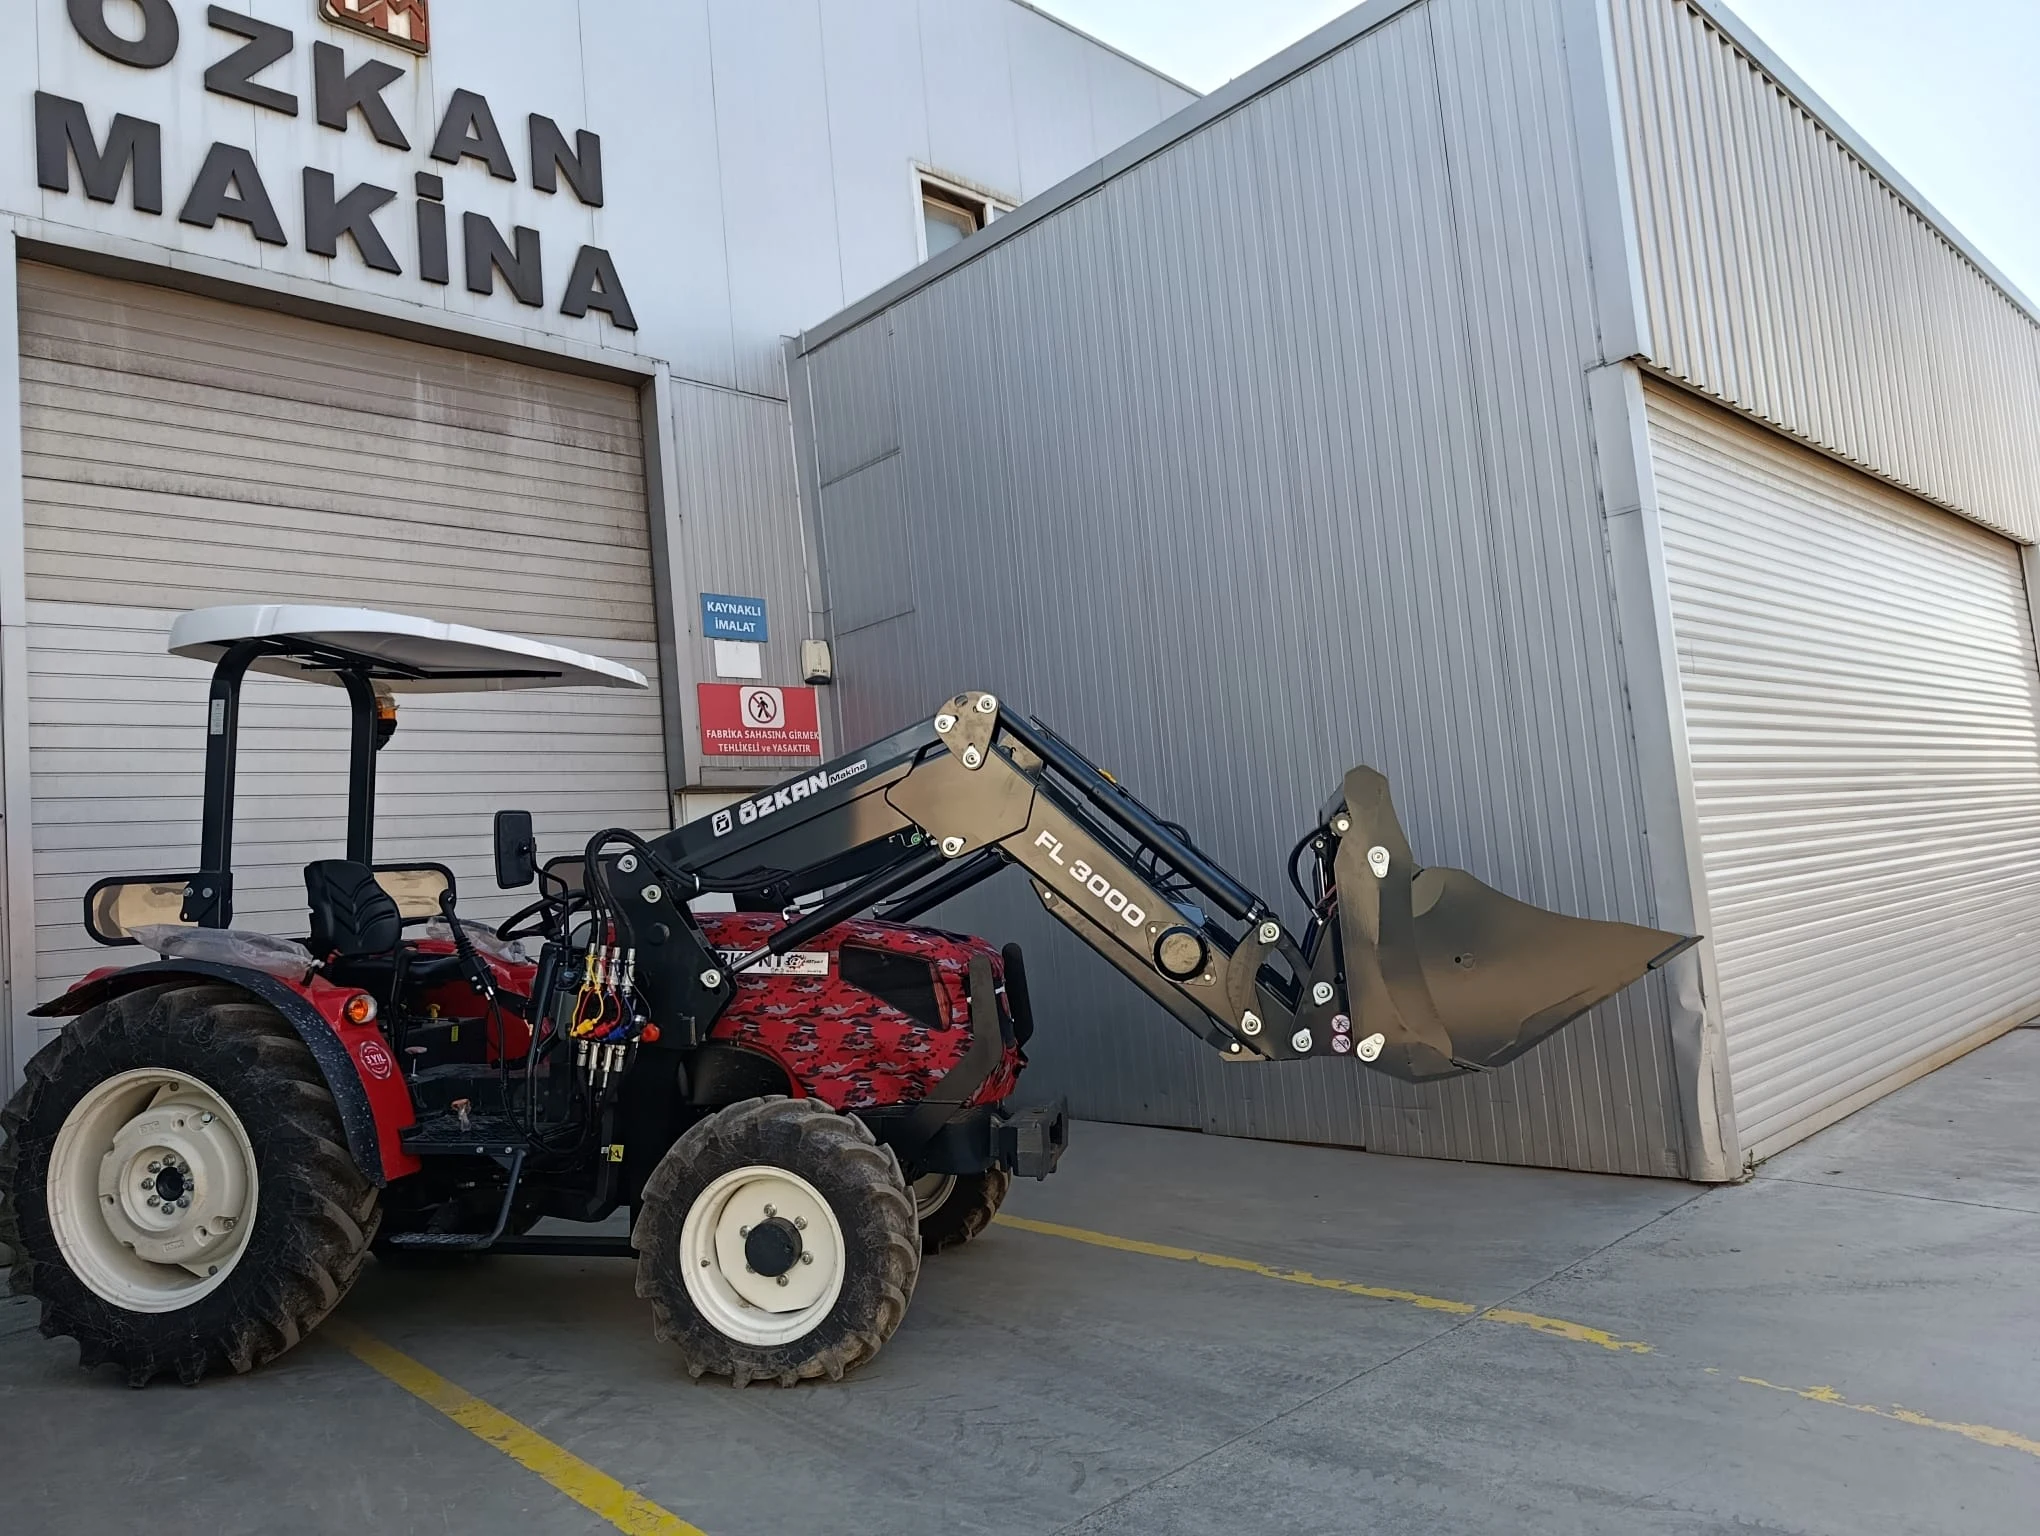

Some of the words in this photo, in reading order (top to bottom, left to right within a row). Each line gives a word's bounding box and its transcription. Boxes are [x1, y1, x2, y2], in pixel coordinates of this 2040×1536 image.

[707, 601, 761, 617] KAYNAKLI
[715, 617, 756, 632] İMALAT
[706, 727, 743, 739] FABRİKA
[744, 730, 788, 740] SAHASINA
[789, 729, 819, 741] GİRMEK
[718, 741, 760, 752] TEHLİKELİ
[761, 745, 771, 753] ve
[773, 743, 812, 753] YASAKTIR
[739, 771, 829, 825] ÖZKAN
[829, 763, 867, 785] Makina
[1034, 830, 1065, 866] FL
[1069, 859, 1146, 928] 3000
